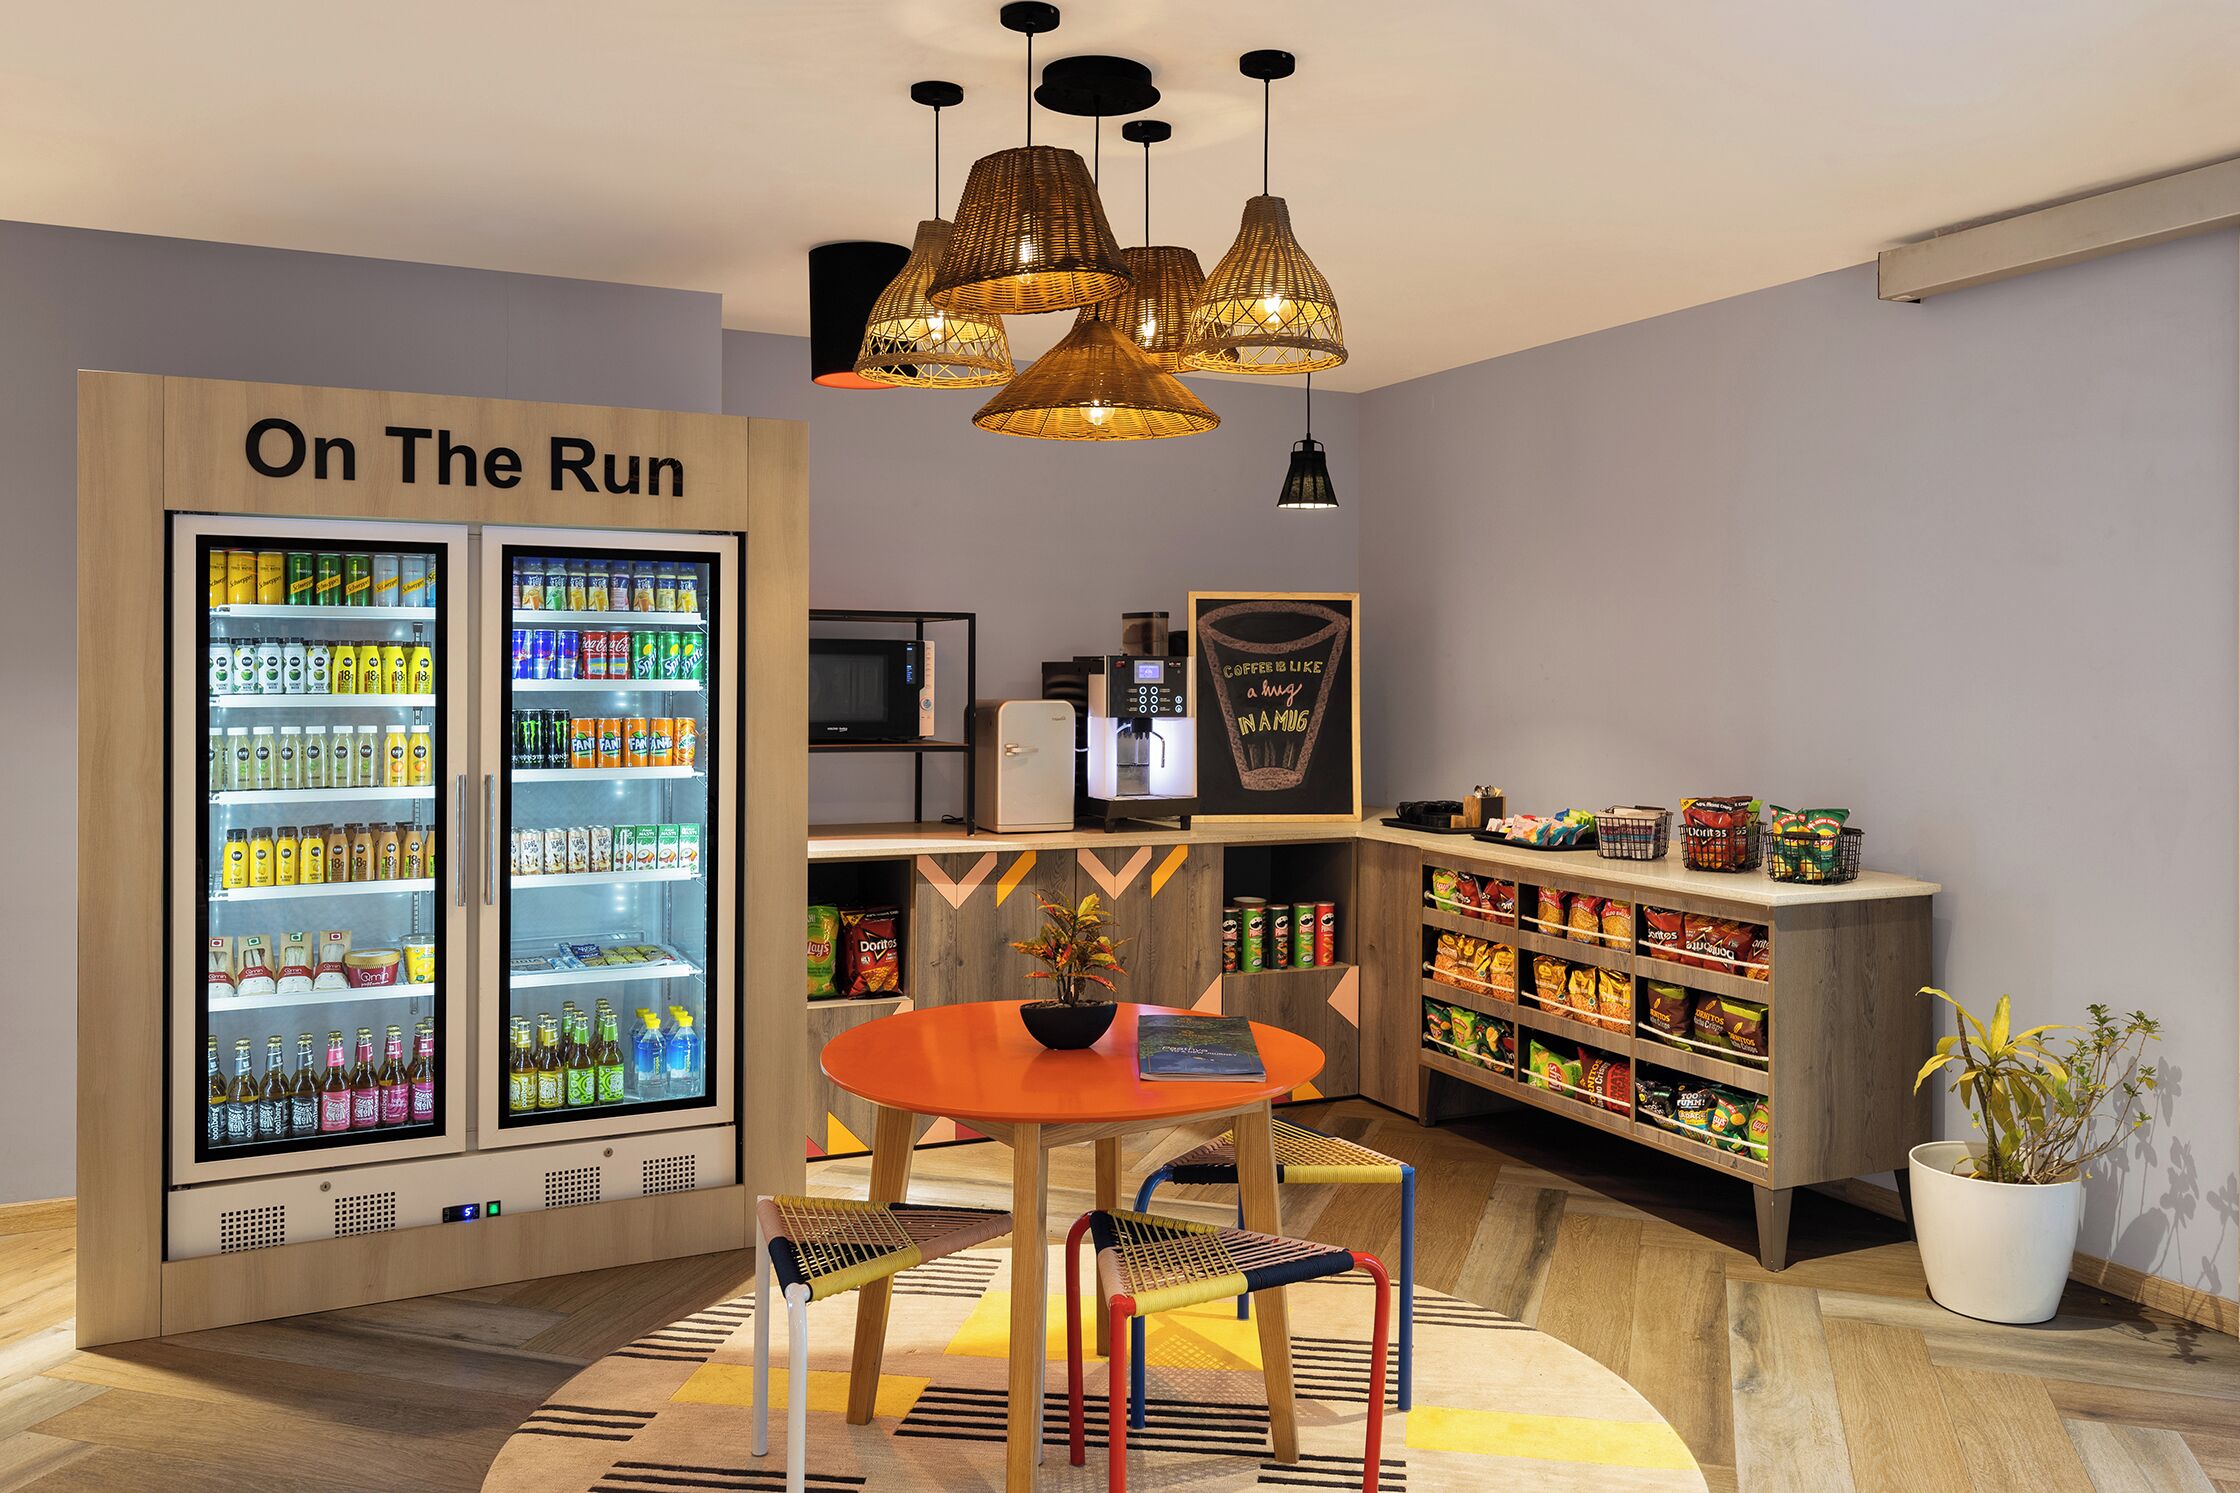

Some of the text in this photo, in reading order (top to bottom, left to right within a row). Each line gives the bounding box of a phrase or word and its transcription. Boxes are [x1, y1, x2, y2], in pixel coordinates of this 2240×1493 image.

[245, 418, 684, 497] On The Run
[1223, 661, 1273, 678] COFFEE
[1290, 661, 1323, 673] LIKE
[1247, 679, 1303, 707] a hug
[1238, 710, 1310, 736] IN A MUG
[1688, 827, 1727, 838] Doritos
[808, 941, 831, 957] Lay's
[860, 939, 897, 952] Doritos
